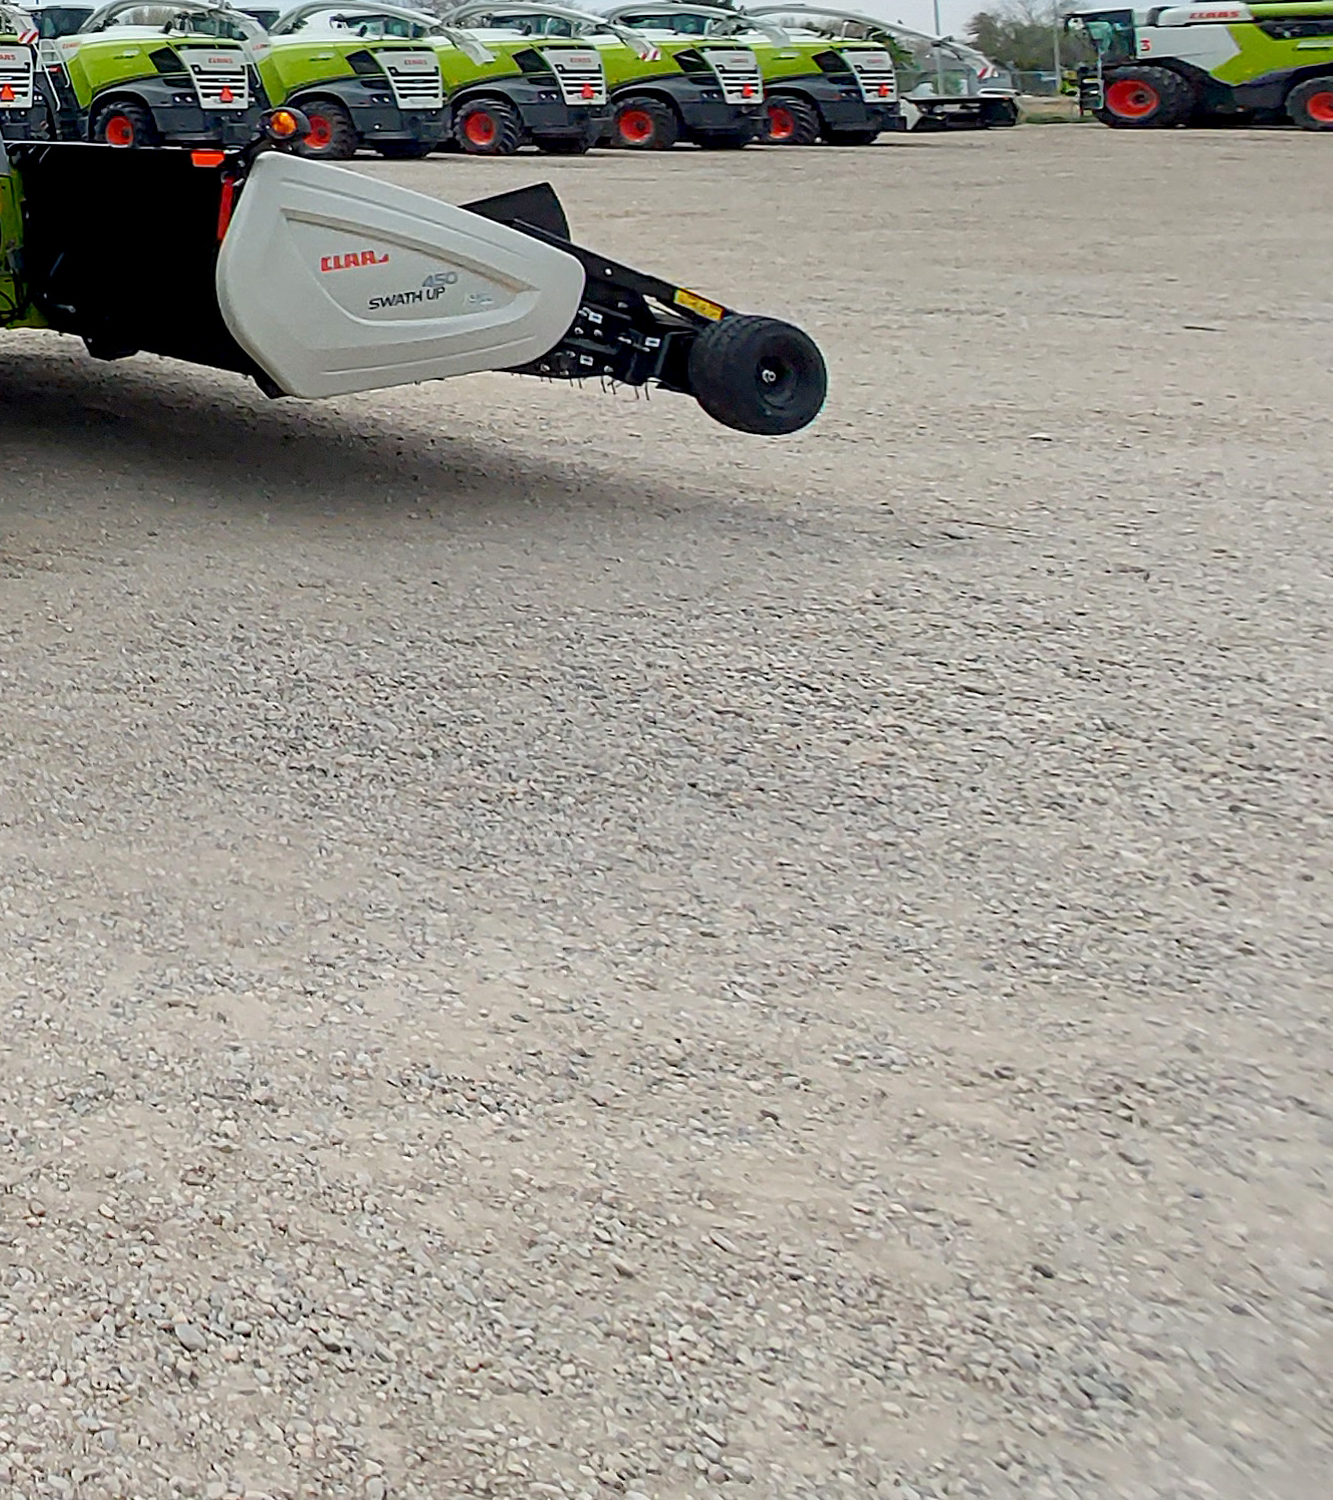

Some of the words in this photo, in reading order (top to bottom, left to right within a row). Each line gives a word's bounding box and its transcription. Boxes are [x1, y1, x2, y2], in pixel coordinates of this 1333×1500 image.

[422, 271, 459, 288] 450
[368, 290, 423, 310] SWATH
[426, 286, 446, 301] UP
